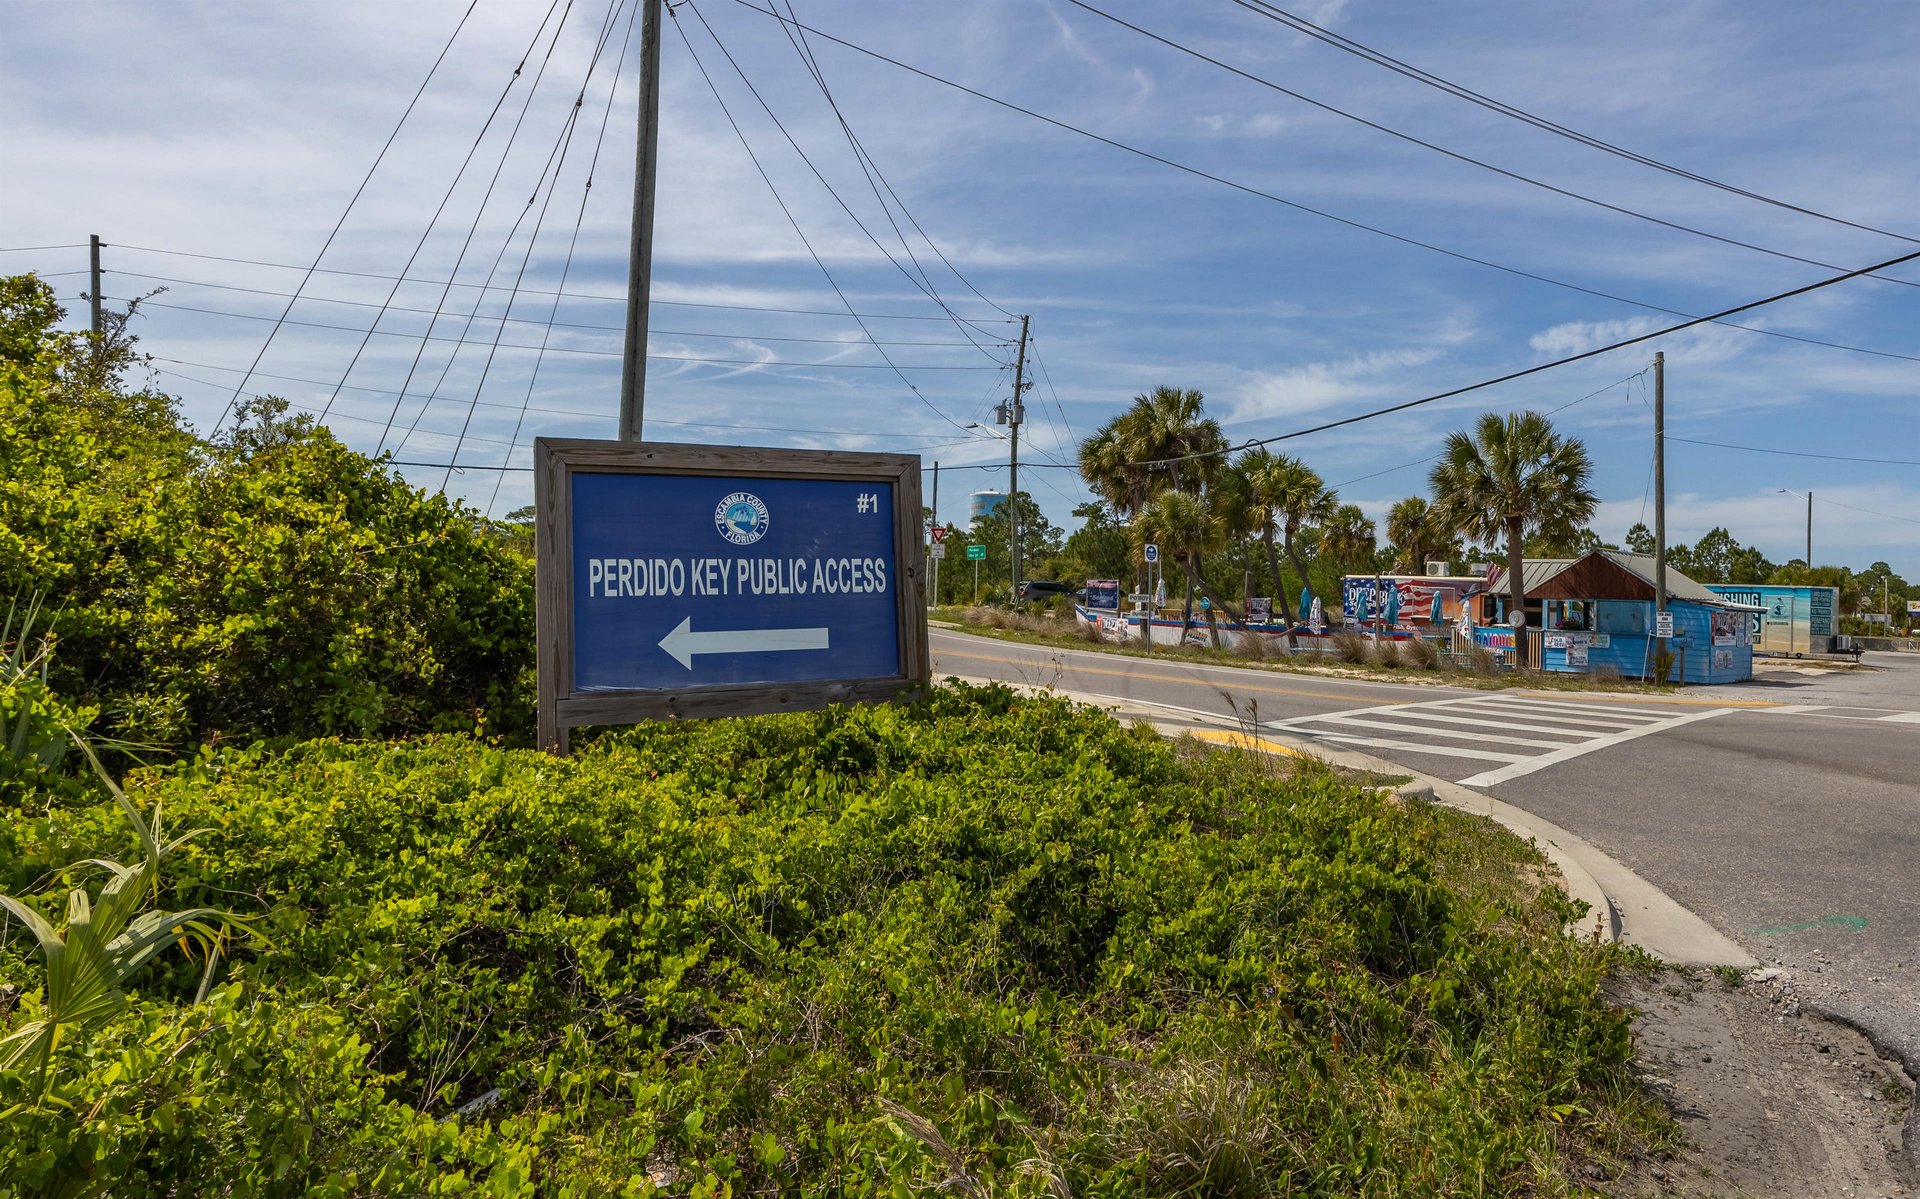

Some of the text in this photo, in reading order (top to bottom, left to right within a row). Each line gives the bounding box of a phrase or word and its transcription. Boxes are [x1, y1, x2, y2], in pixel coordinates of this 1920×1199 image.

[716, 494, 769, 525] ESCAMBIA COUNTY
[857, 493, 878, 513] #1
[725, 531, 761, 544] FLORIDA
[589, 558, 887, 597] PERDIDO KEY PUBLIC ACCESS
[1718, 593, 1759, 606] ISHING
